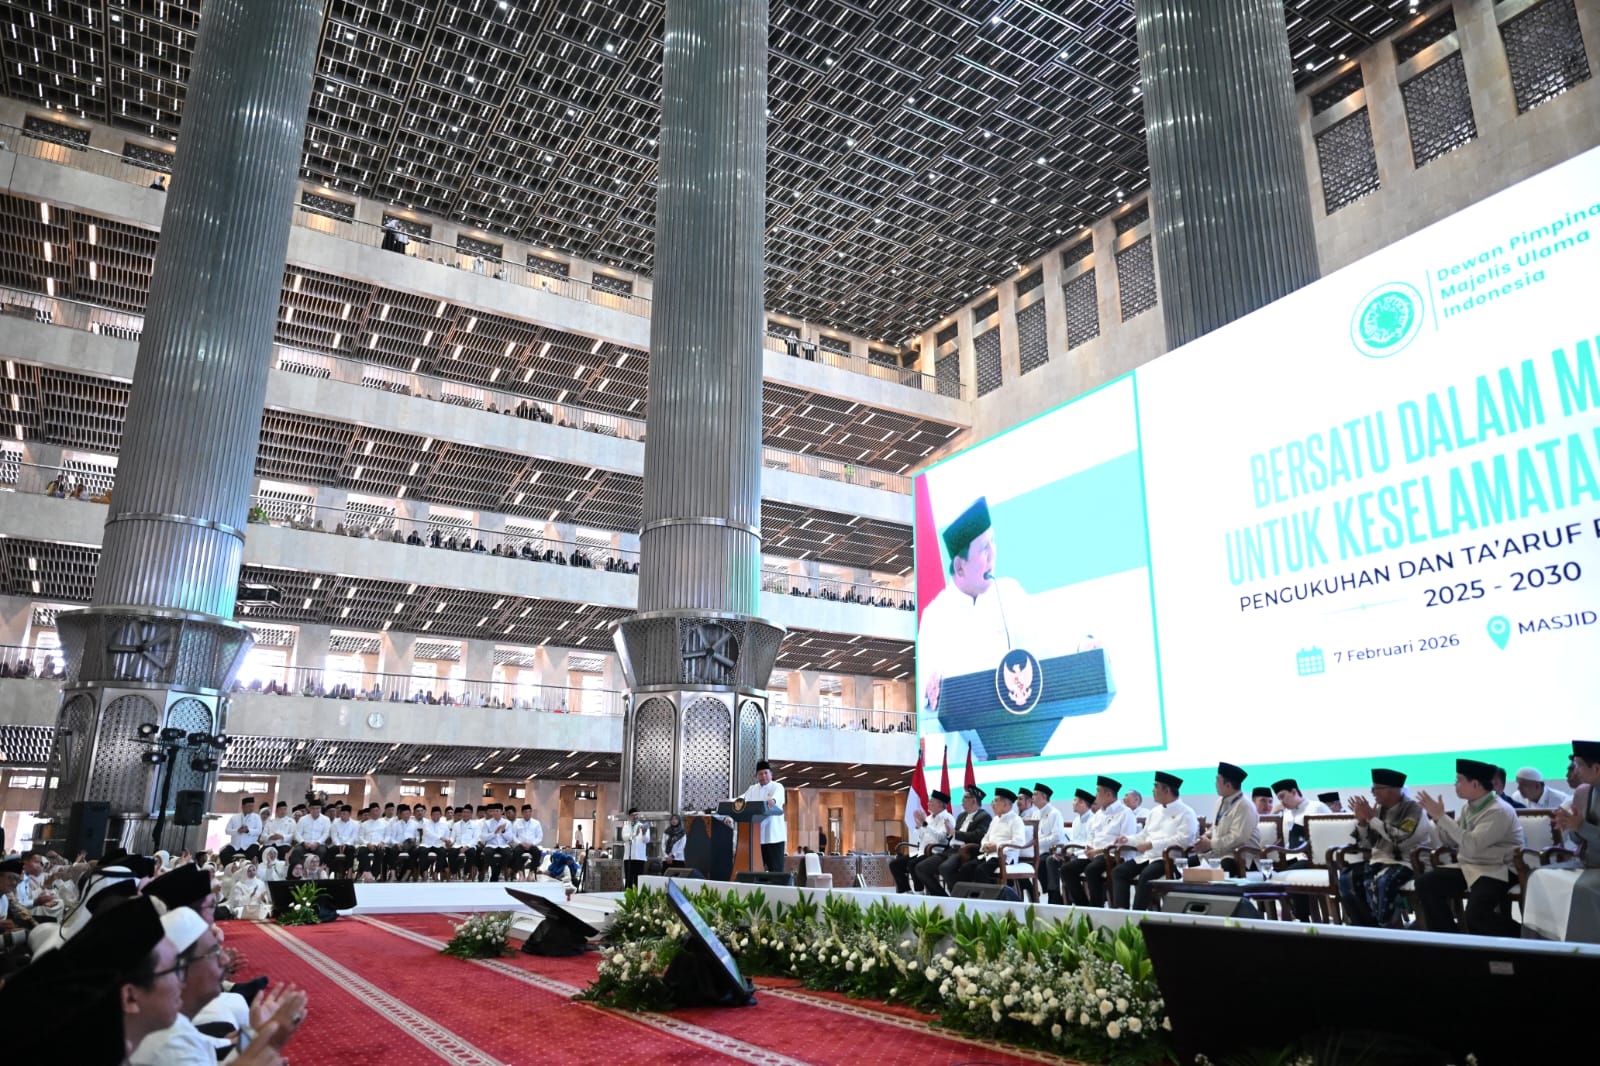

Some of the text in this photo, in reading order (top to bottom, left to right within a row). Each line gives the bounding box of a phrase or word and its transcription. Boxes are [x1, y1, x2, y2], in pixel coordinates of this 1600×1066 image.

[1437, 245, 1503, 281] Dewan
[1440, 229, 1590, 300] Majelis Ulama
[1444, 269, 1545, 318] Indonesia
[1250, 410, 1390, 509] BERSATU
[1397, 358, 1545, 465] DALAM
[1225, 506, 1329, 586] UNTUK
[1240, 565, 1390, 612] PENGUKUHAN
[1399, 551, 1454, 579] DAN
[1460, 522, 1582, 565] TA'ARUF
[1424, 579, 1485, 607] 2025
[1510, 561, 1582, 591] 2030
[1518, 610, 1597, 635] MASJID
[1333, 633, 1460, 664] 7 Februari 2026
